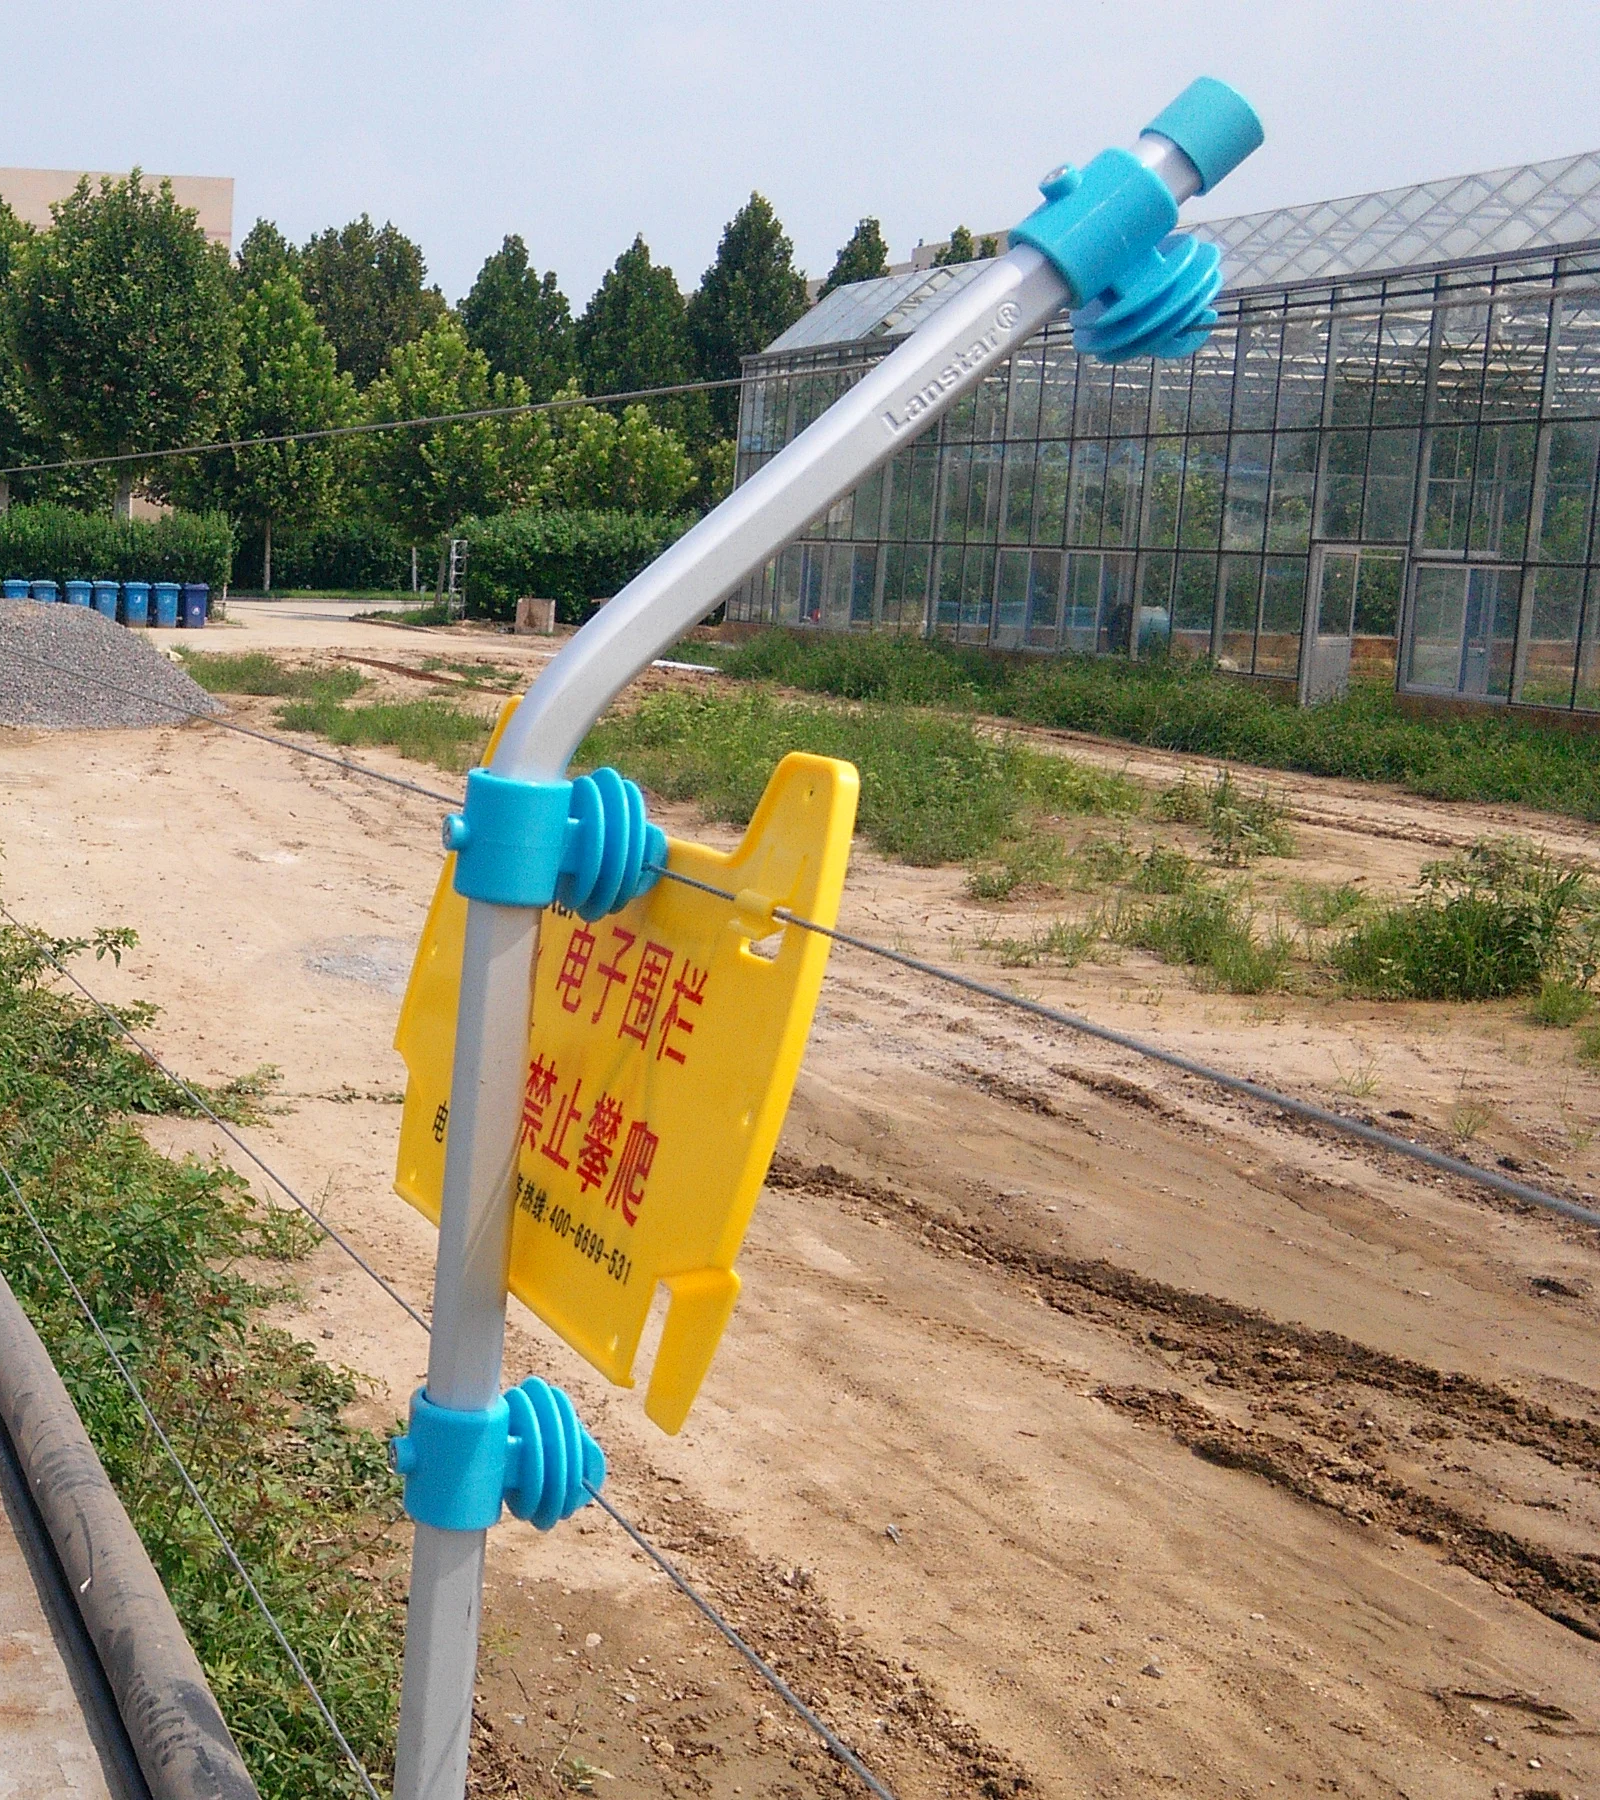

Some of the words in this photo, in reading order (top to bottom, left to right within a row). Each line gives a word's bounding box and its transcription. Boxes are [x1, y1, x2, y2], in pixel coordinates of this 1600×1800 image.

[555, 922, 707, 1065] 电子围栏
[520, 1053, 659, 1227] 禁止攀爬
